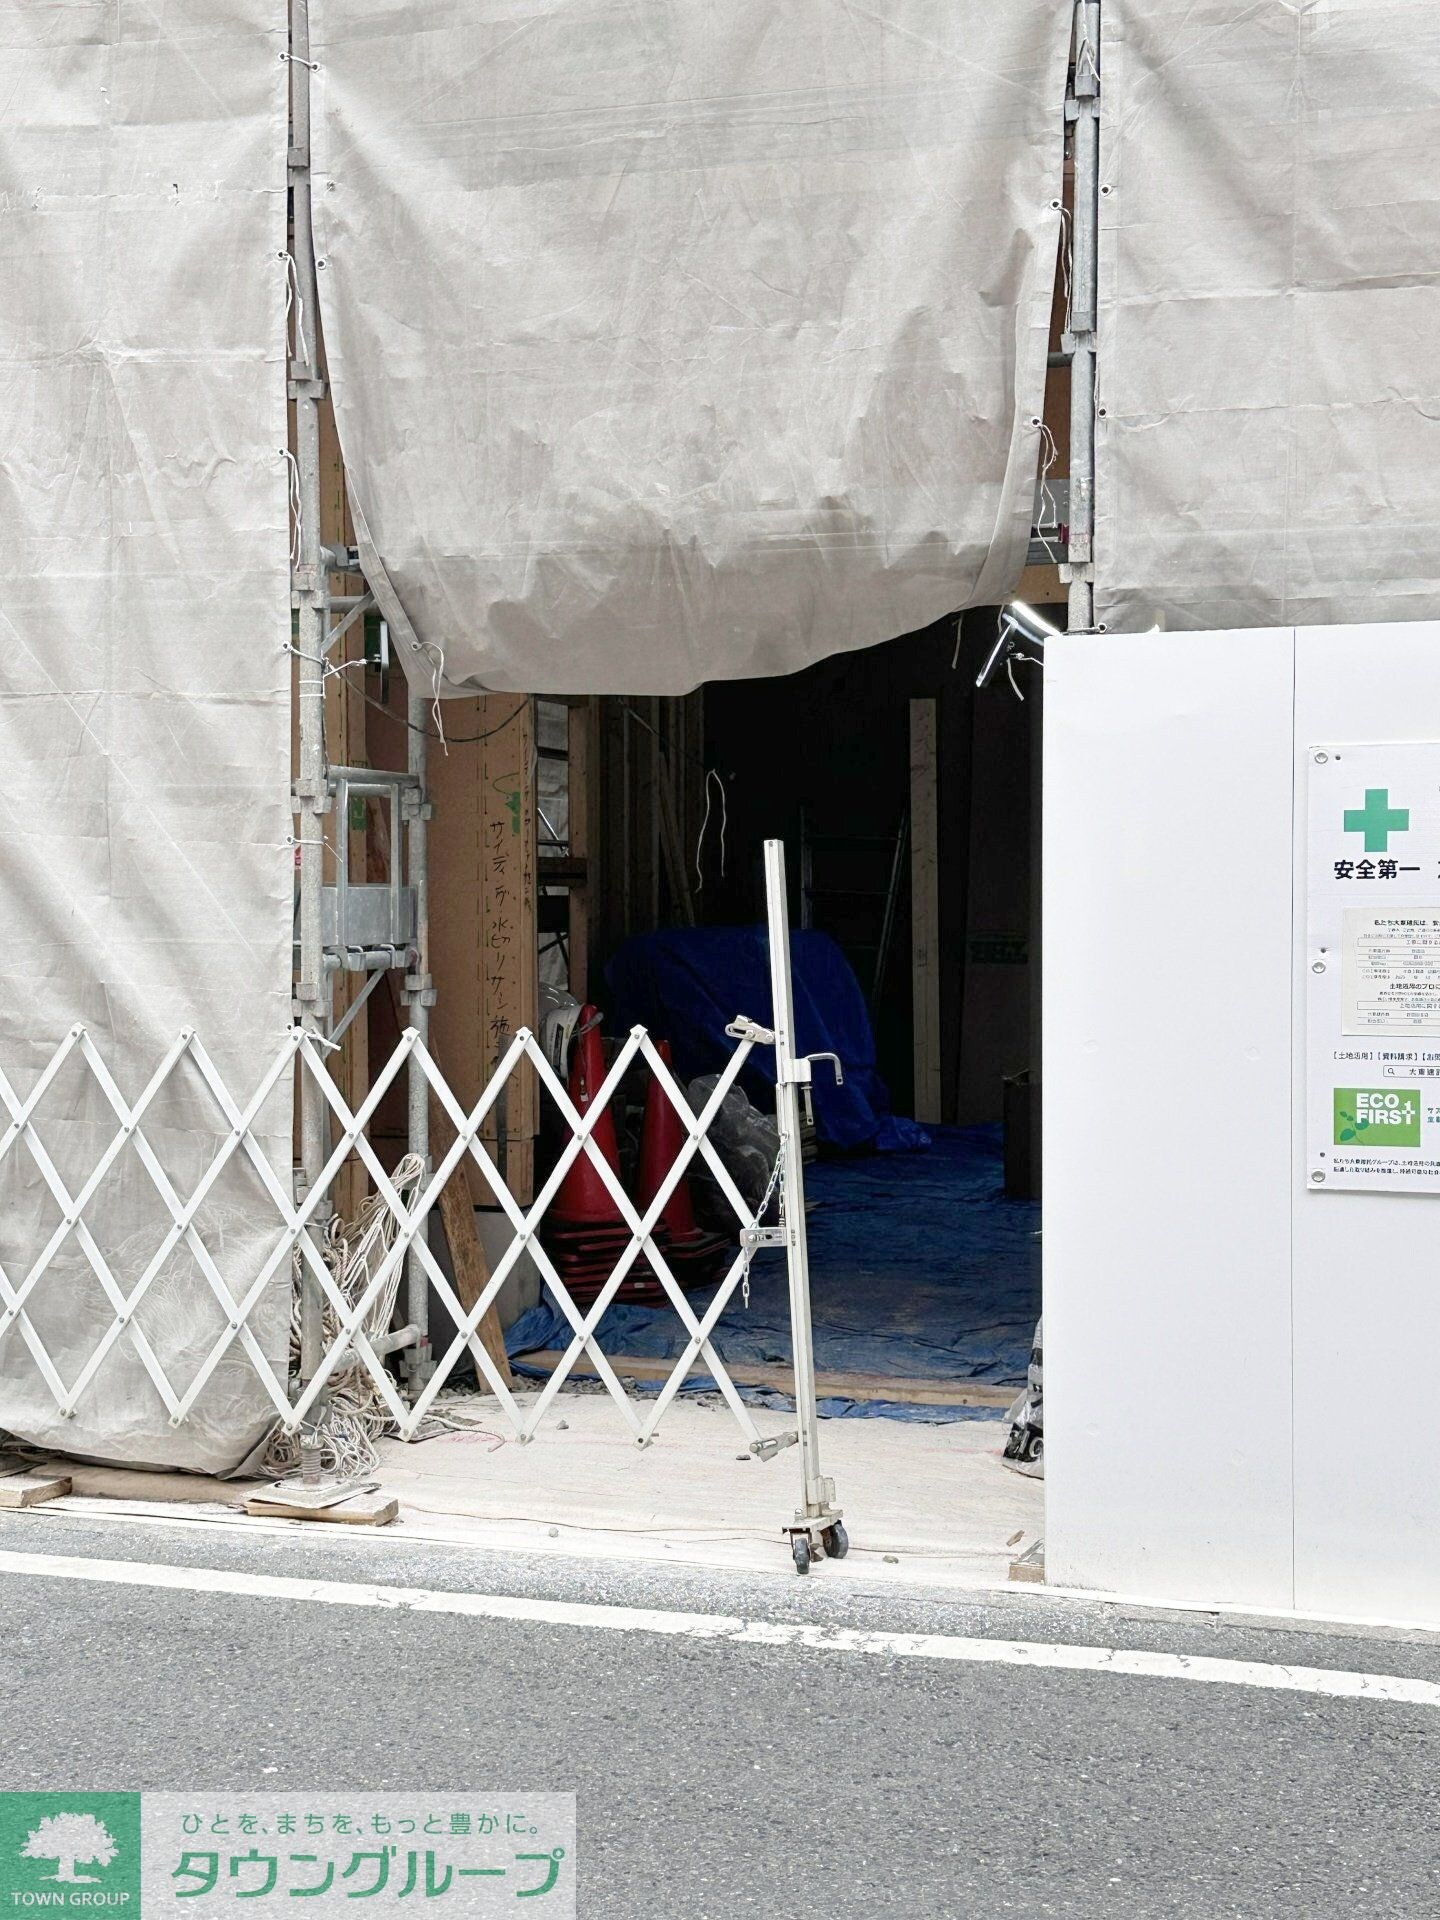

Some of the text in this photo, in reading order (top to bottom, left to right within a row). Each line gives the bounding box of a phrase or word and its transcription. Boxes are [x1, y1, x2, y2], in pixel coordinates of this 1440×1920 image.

[1334, 859, 1420, 880] 安全第一
[1356, 1093, 1400, 1108] ECO
